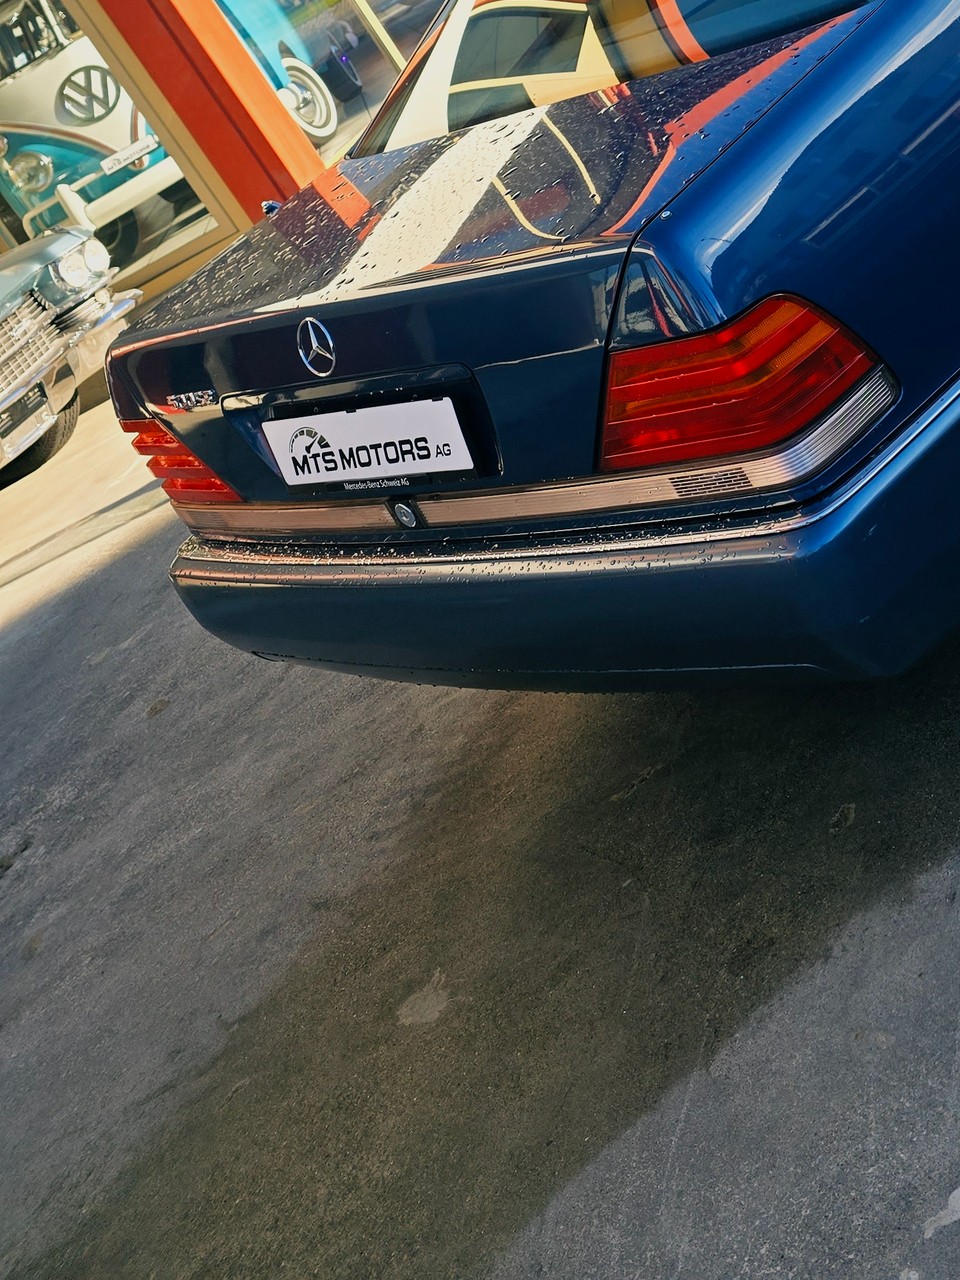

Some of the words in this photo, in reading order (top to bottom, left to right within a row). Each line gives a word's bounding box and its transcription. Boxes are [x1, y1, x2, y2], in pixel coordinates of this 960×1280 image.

[291, 451, 338, 476] MTS
[339, 437, 431, 470] MOTORS
[435, 443, 452, 458] AG
[343, 480, 380, 490] Mercedes-Benz
[380, 478, 400, 488] Schweiz
[401, 478, 410, 486] AG
